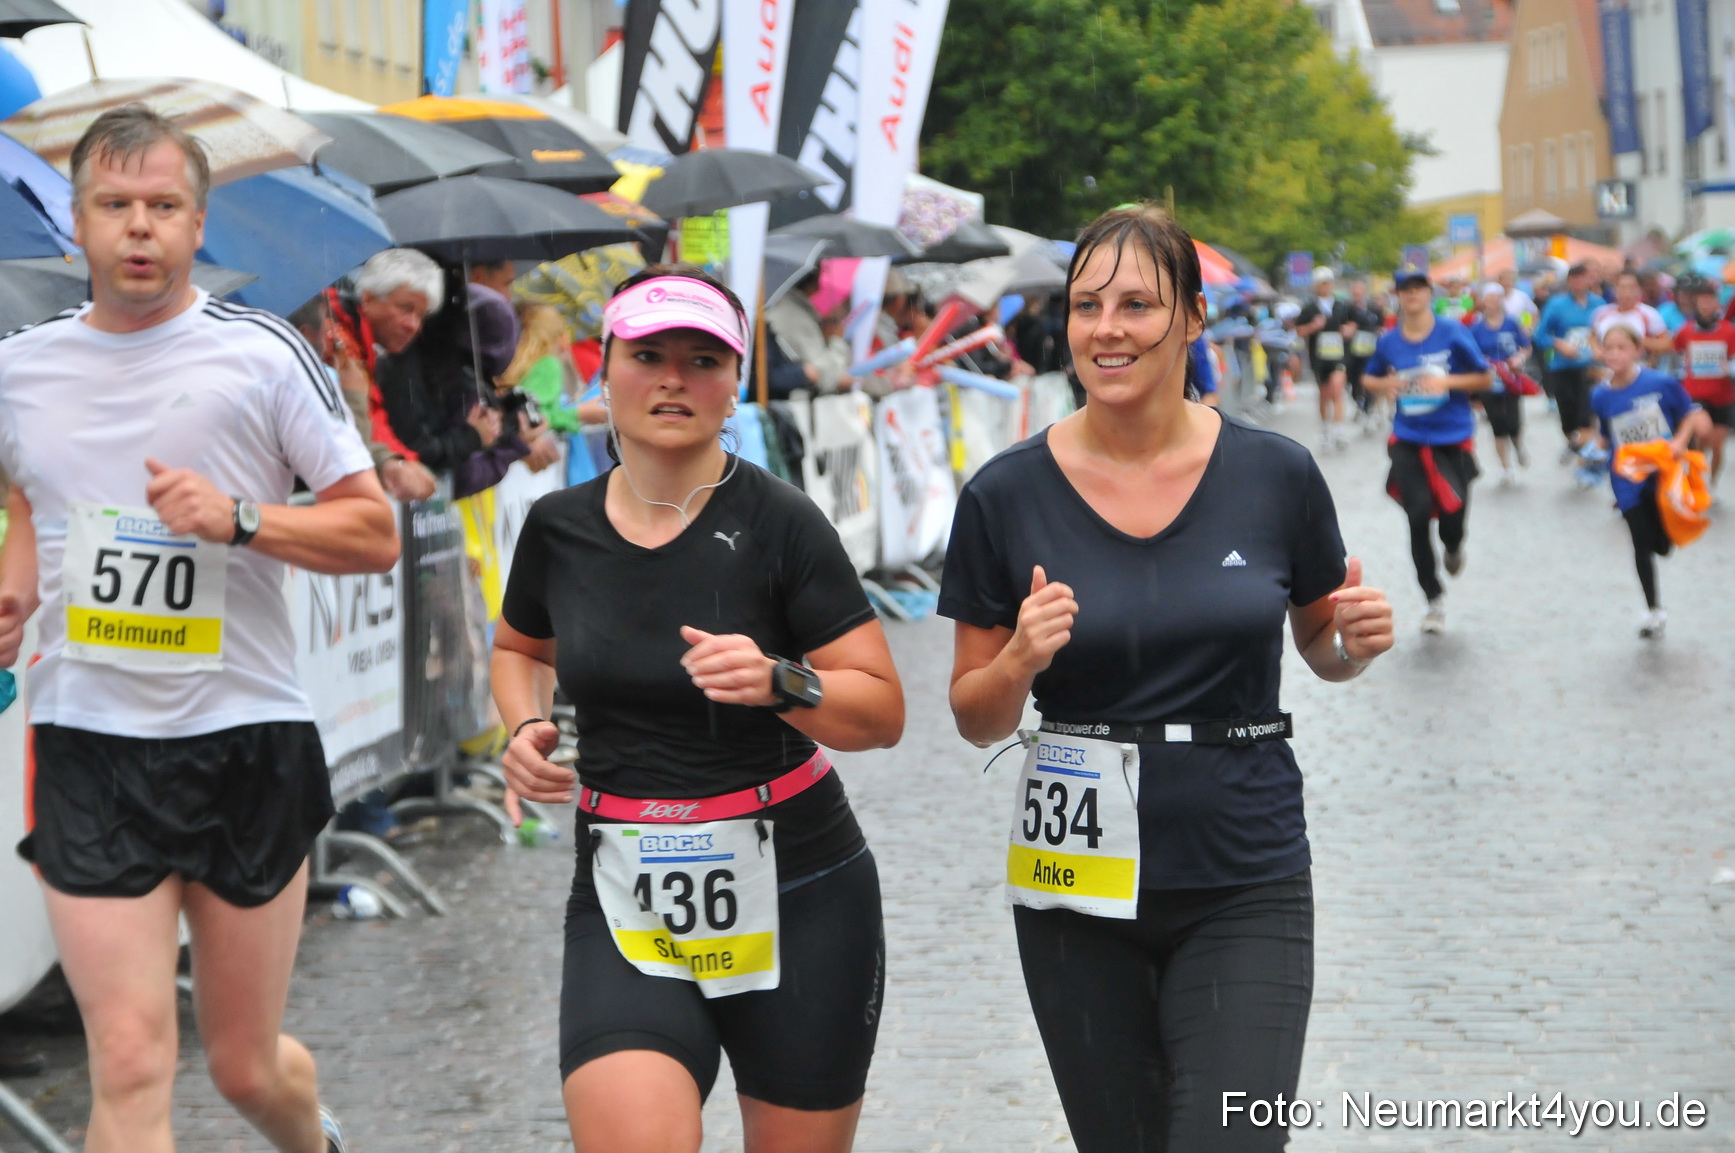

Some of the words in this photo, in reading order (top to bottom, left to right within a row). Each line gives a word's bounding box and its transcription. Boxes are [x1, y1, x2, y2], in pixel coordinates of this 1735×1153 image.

[880, 22, 914, 152] Audi
[116, 516, 177, 536] BOC
[91, 547, 195, 611] 570
[86, 616, 188, 647] Reimund
[1037, 743, 1085, 765] BOCK
[1023, 779, 1103, 849] 534
[639, 834, 713, 852] BOCK
[1033, 859, 1075, 887] Anke
